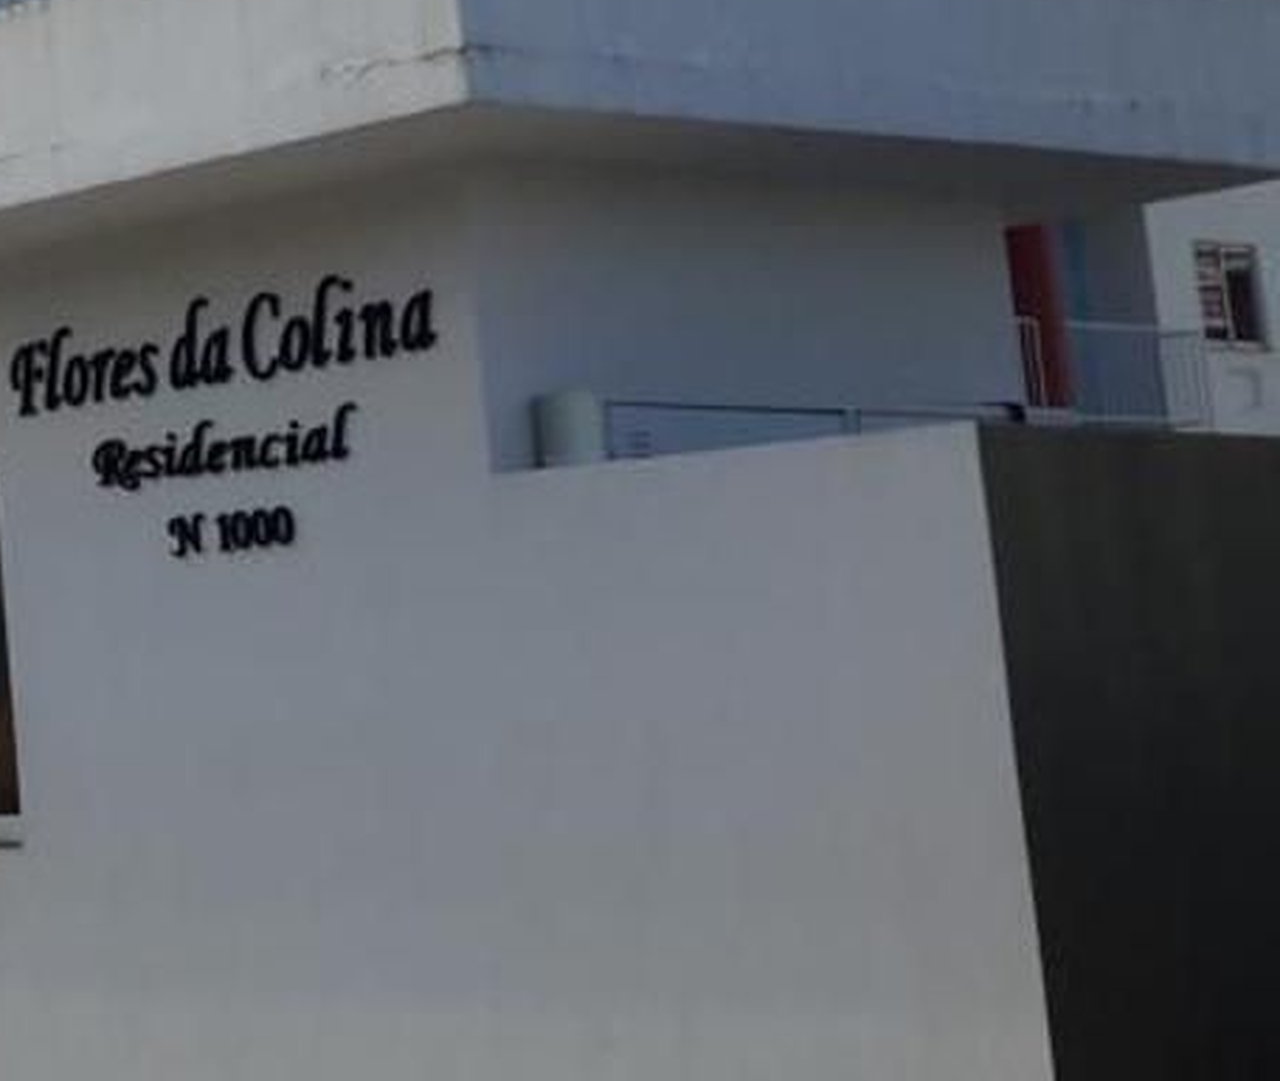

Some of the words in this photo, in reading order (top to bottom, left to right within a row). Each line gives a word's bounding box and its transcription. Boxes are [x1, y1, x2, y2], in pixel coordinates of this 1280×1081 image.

[10, 325, 159, 417] Flores
[169, 296, 235, 391] da
[241, 274, 437, 381] Colina
[92, 402, 357, 490] Residencial
[215, 506, 296, 553] 1000
